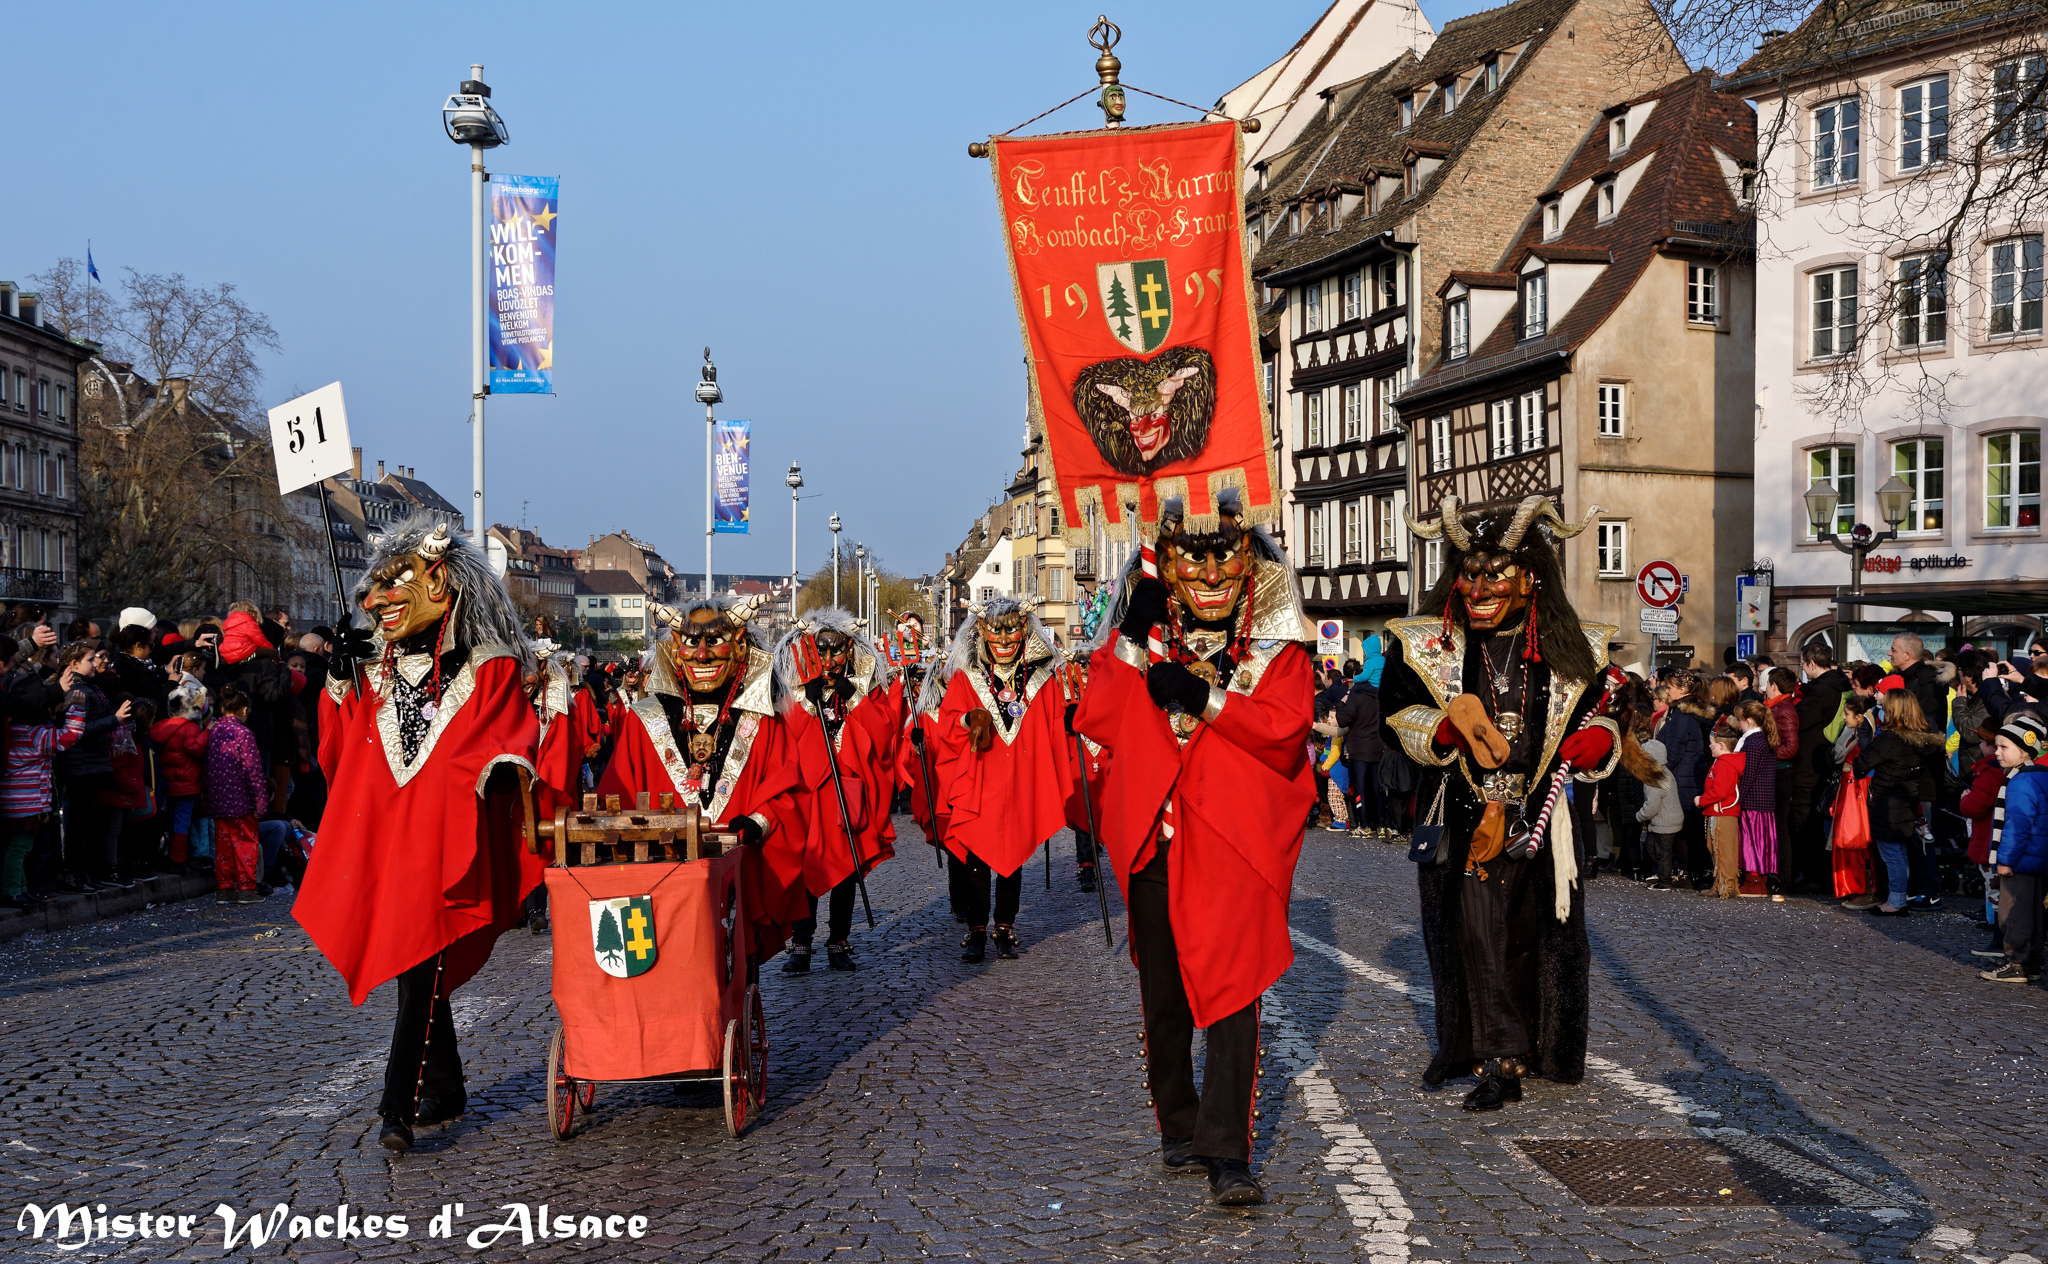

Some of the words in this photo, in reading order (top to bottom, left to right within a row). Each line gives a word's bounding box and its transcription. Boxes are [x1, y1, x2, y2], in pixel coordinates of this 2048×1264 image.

[490, 220, 545, 245] WILL-
[494, 242, 542, 266] KOM-
[495, 264, 536, 288] MEN
[497, 284, 554, 301] BOAS-VINDAS
[499, 310, 538, 322] BENVENUTO
[500, 320, 530, 331] WELKOM
[286, 406, 327, 454] 51
[716, 452, 742, 466] BIEN-
[716, 462, 748, 477] VENUE
[1850, 555, 1901, 573] uisine
[1910, 553, 1967, 571] aptitude
